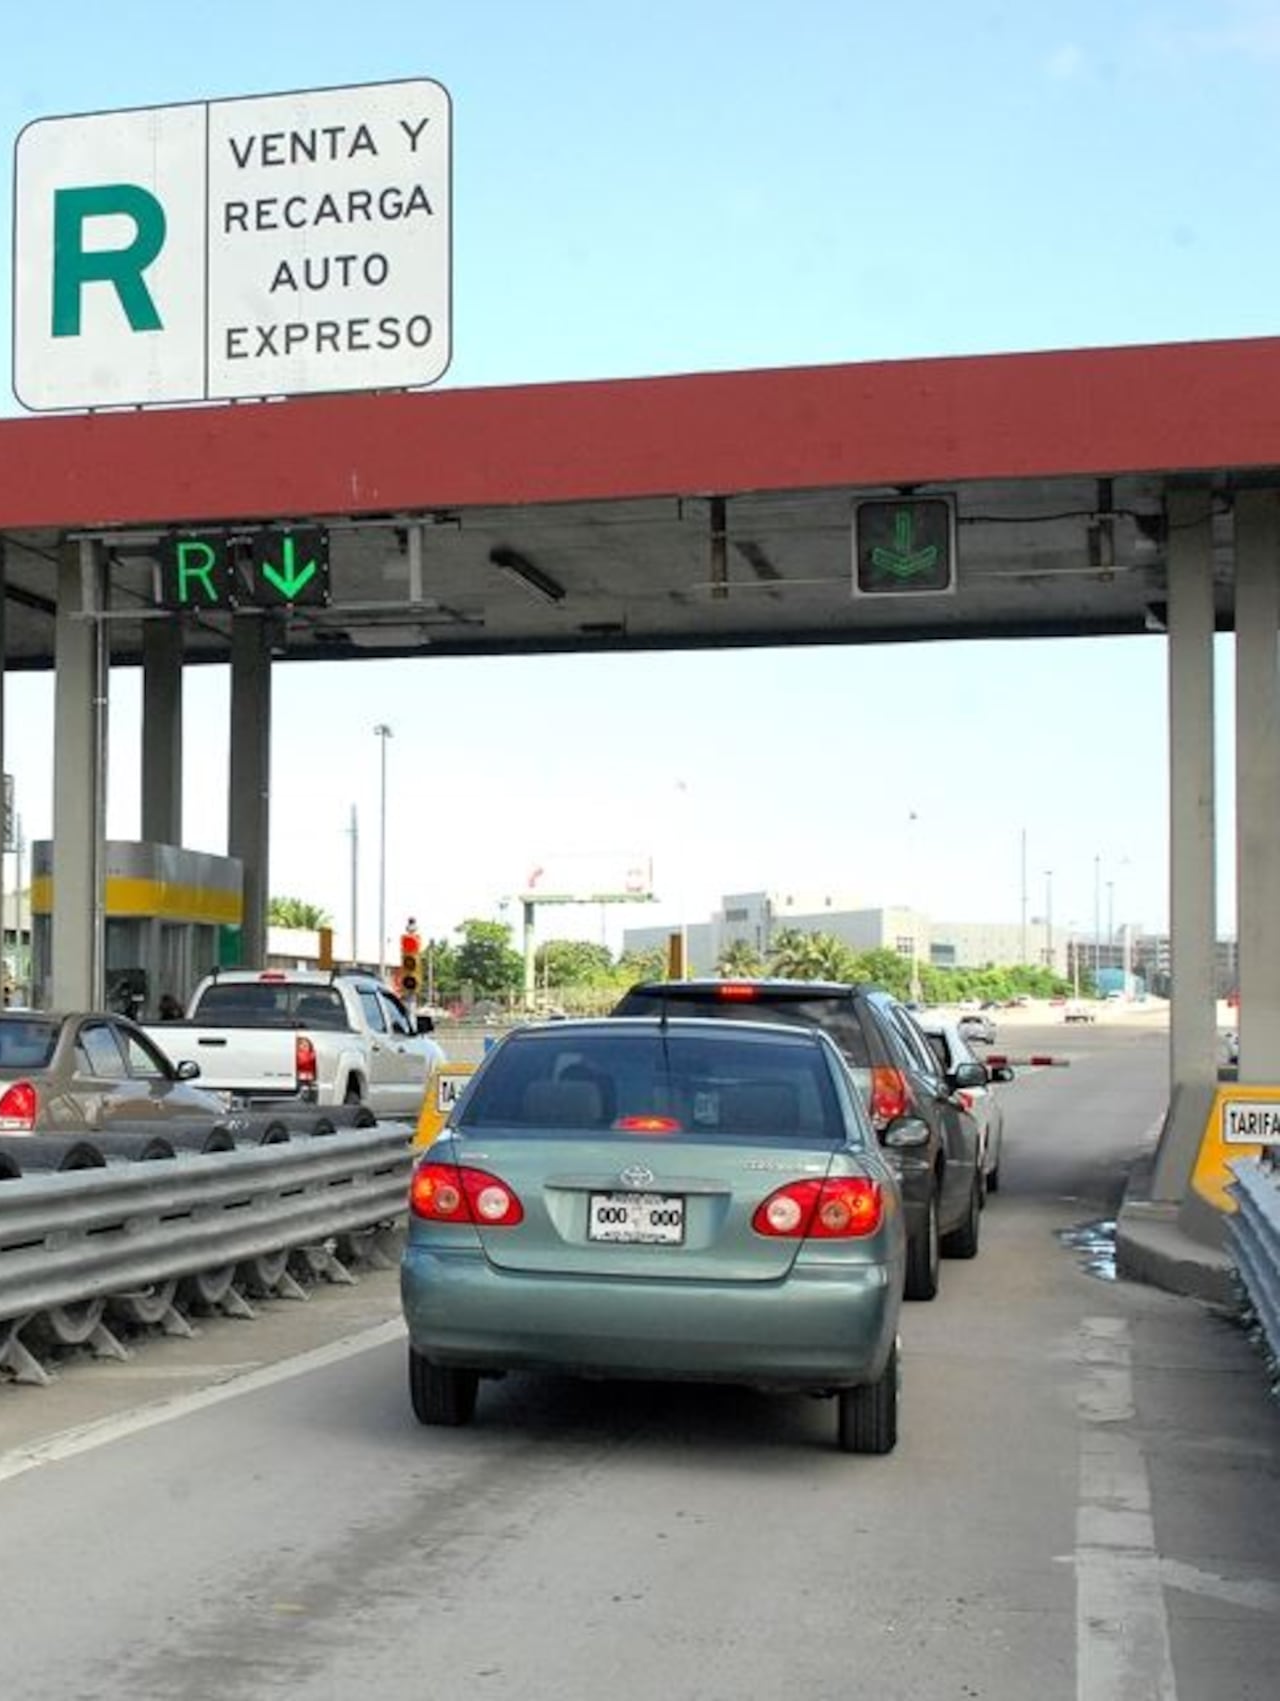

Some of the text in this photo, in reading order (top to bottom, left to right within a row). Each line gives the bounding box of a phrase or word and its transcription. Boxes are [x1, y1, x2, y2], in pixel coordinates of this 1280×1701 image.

[229, 118, 430, 169] VENTA Y
[224, 186, 434, 233] RECARGA
[51, 184, 167, 338] R
[270, 254, 389, 293] AUTO
[226, 315, 433, 360] EXPRESO
[177, 542, 218, 602] R
[1230, 1111, 1280, 1135] TARIFA
